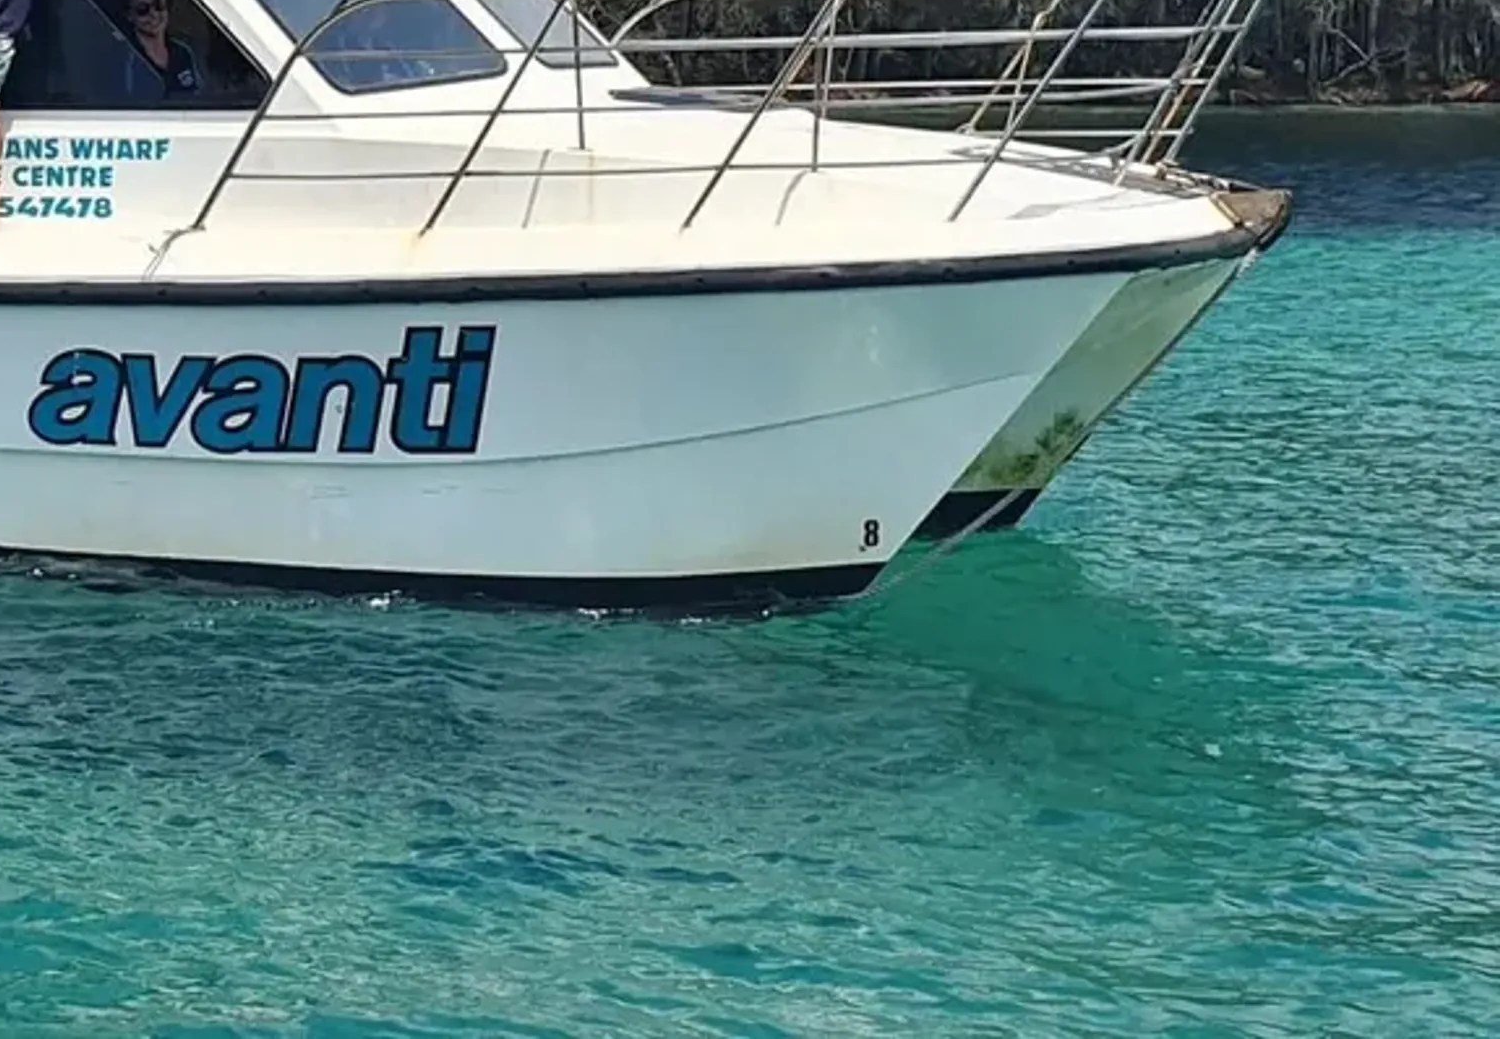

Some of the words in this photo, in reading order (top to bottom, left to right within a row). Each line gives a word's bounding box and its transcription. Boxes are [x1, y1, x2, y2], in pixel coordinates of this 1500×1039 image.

[69, 137, 170, 160] WHARF
[12, 165, 114, 187] CENTRE
[27, 326, 497, 455] avanti
[864, 519, 880, 547] 8
